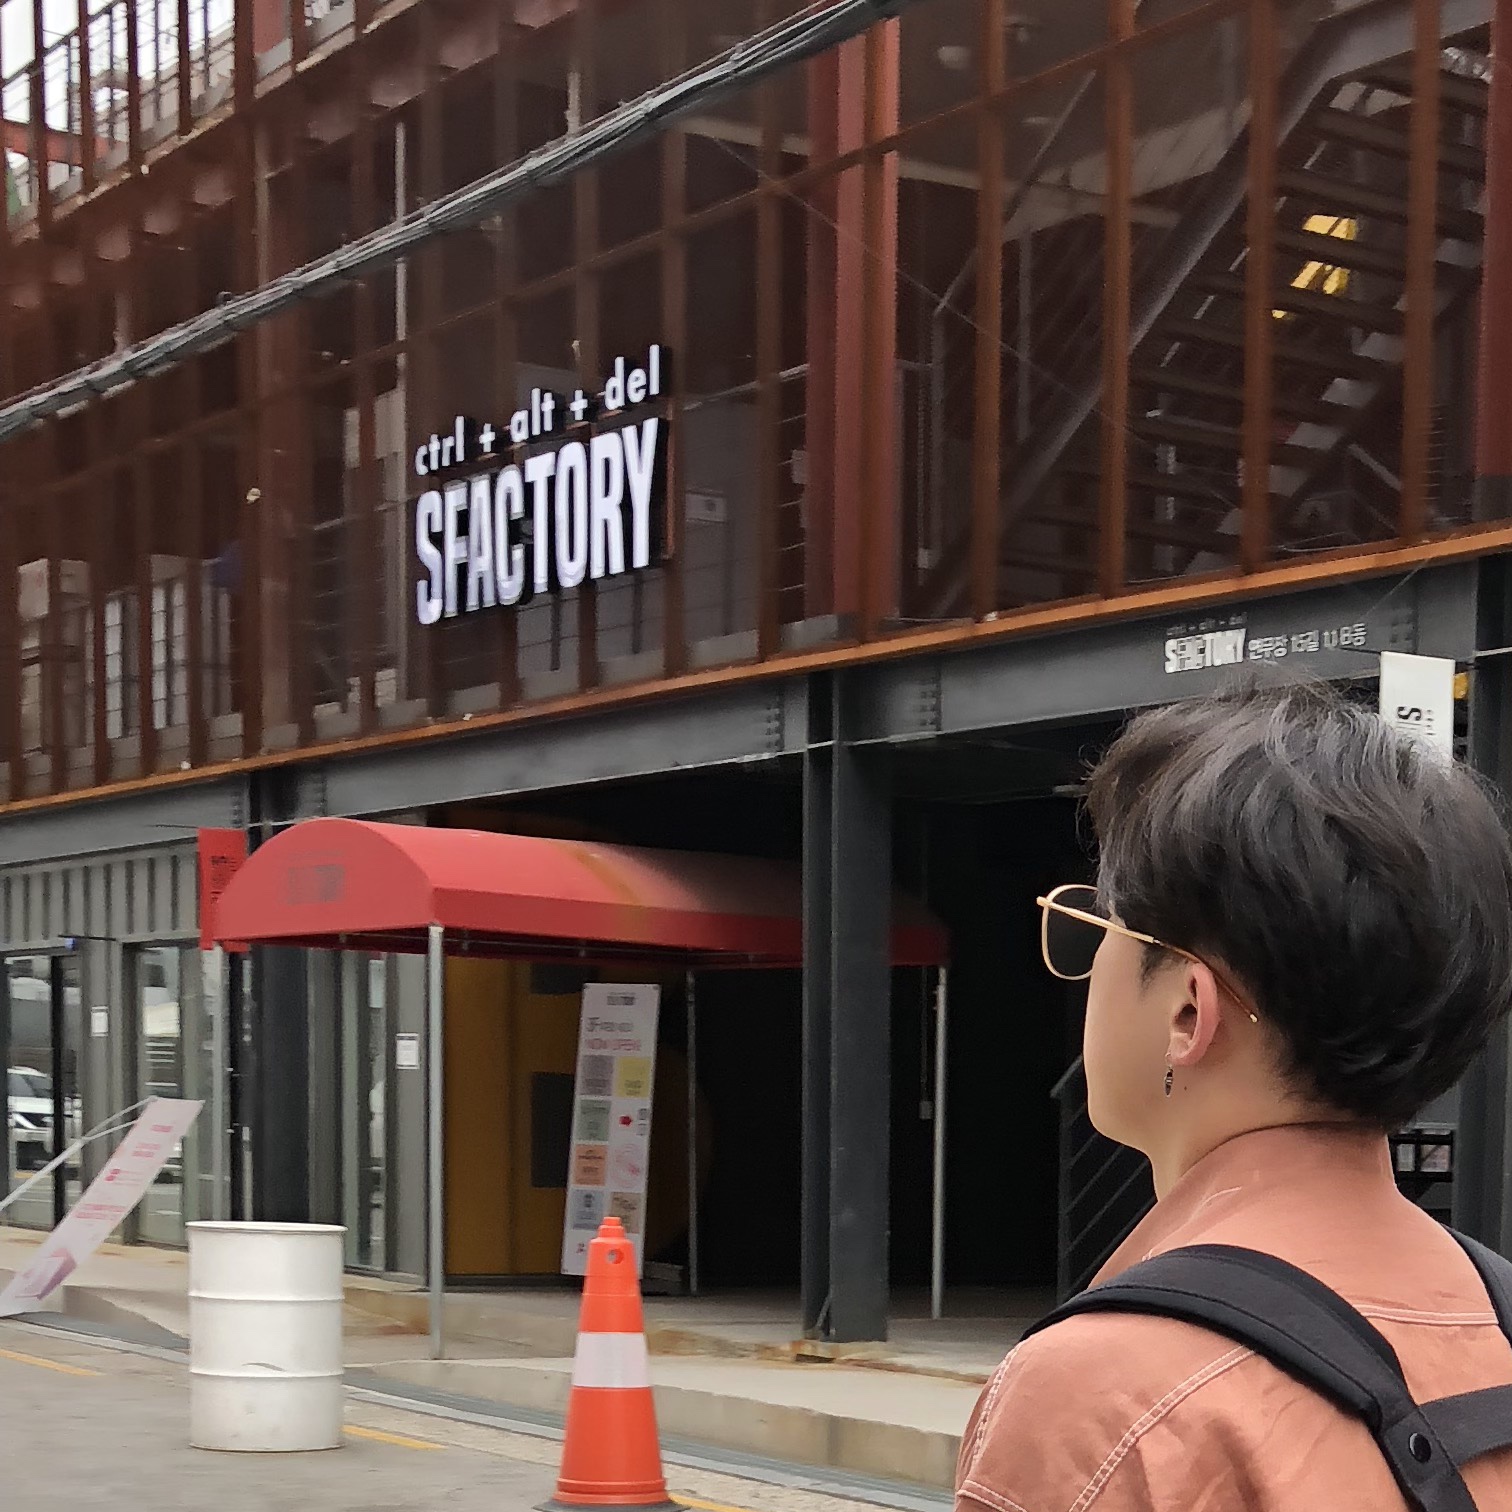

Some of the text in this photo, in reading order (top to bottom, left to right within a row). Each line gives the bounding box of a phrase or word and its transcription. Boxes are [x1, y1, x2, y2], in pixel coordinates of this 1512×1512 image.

[415, 415, 465, 476] ctrl
[510, 387, 556, 443] alt
[604, 344, 660, 411] del
[415, 417, 659, 625] SFACTORY
